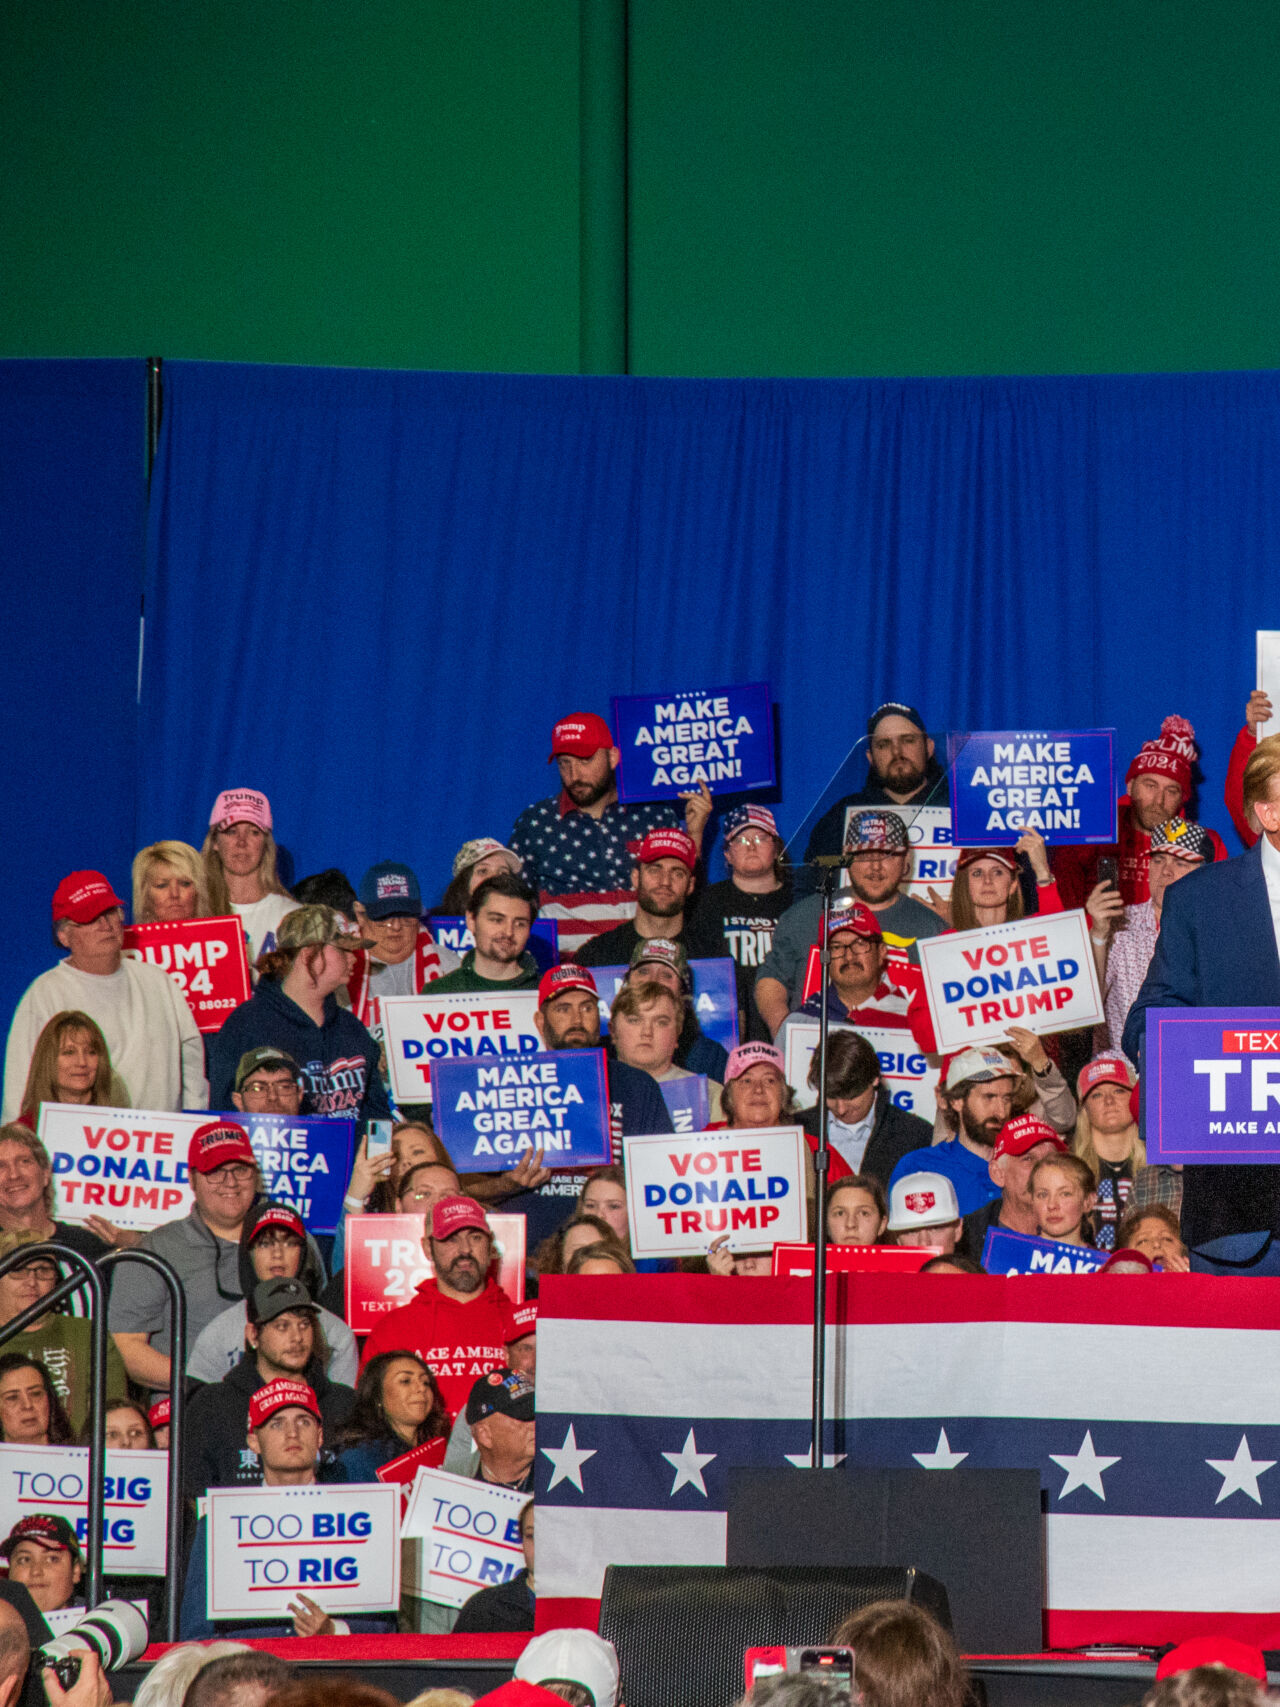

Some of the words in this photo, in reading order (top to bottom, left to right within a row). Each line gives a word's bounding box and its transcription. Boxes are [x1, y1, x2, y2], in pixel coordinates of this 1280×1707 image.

[654, 697, 729, 723] MAKE
[635, 716, 753, 746] AMERICA
[651, 739, 738, 766] GREAT
[994, 742, 1070, 763] MAKE
[1138, 755, 1178, 773] 2024
[651, 759, 742, 786] AGAIN!
[971, 764, 1095, 787] AMERICA
[987, 787, 1078, 808] GREAT
[861, 819, 885, 827] ULTRA
[861, 826, 884, 834] MAGA
[986, 810, 1080, 830] AGAIN!
[723, 917, 728, 927] I
[730, 916, 772, 927] STAND
[962, 935, 1050, 971] VOTE
[942, 958, 1079, 1004] DONALD
[199, 997, 237, 1010] 88022
[958, 986, 1074, 1028] TRUMP
[423, 1009, 512, 1033] VOTE
[402, 1035, 539, 1059] DONALD
[736, 1045, 778, 1059] TRUMP
[477, 1063, 558, 1088] MAKE
[878, 1052, 927, 1075] BIG
[455, 1084, 583, 1112] AMERICA
[473, 1108, 568, 1133] GREAT
[1007, 1117, 1028, 1131] MAKE
[1209, 1121, 1258, 1134] MAKE
[83, 1126, 174, 1155] VOTE
[199, 1131, 243, 1148] TRUMP
[251, 1128, 308, 1150] AKE
[472, 1130, 572, 1157] AGAIN!
[1013, 1126, 1036, 1140] GREAT
[668, 1148, 763, 1177] VOTE
[61, 1181, 183, 1212] TRUMP
[643, 1176, 790, 1208] DONALD
[657, 1205, 780, 1235] TRUMP
[361, 1302, 393, 1312] TEXT
[252, 1384, 275, 1403] MAKE
[275, 1381, 311, 1396] AMERICA
[259, 1394, 283, 1412] GREAT
[284, 1391, 308, 1404] AGAIN
[238, 1450, 260, 1469] 東
[13, 1471, 83, 1498] TOO
[230, 1514, 302, 1540] TOO
[312, 1512, 372, 1538] BIG
[432, 1498, 497, 1535] TOO
[244, 1559, 289, 1583] TO
[298, 1557, 358, 1583] RIG
[433, 1543, 472, 1574] TO
